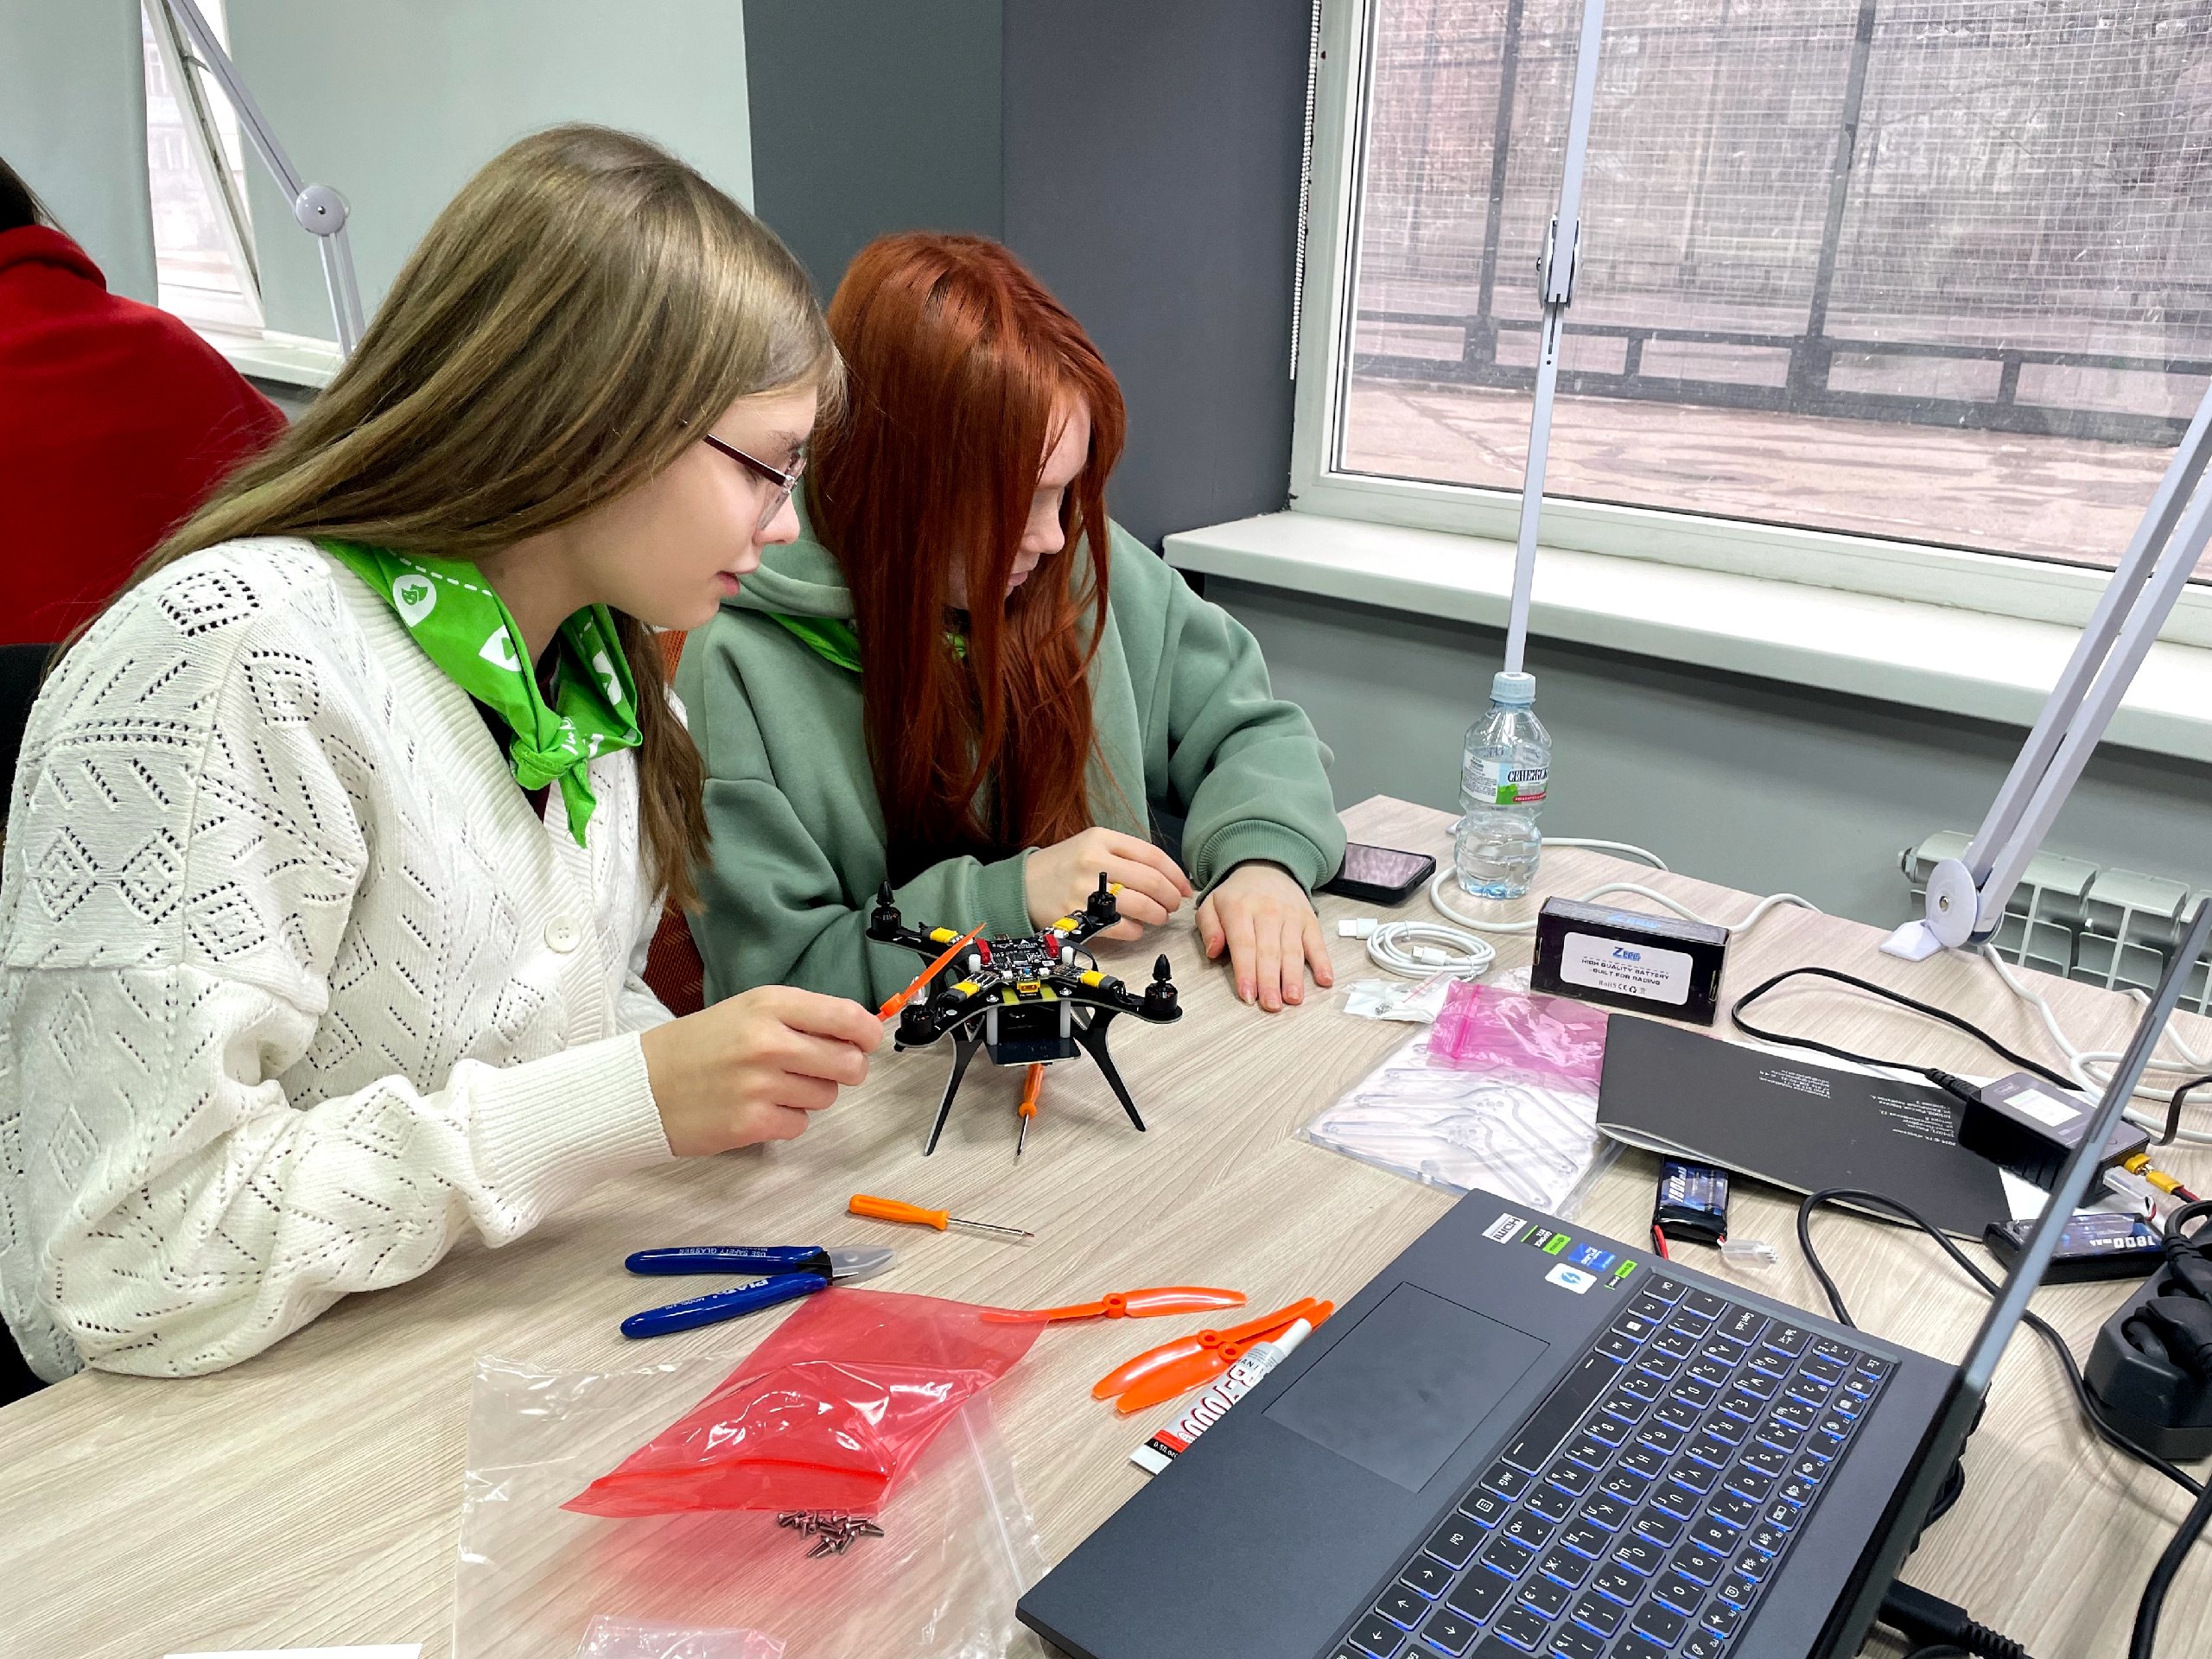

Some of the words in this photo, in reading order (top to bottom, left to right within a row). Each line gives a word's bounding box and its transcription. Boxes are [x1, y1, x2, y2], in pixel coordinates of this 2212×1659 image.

[1601, 963, 1632, 972] QUALITY
[1635, 969, 1669, 979] BATTERY
[1493, 1217, 1521, 1241] HDMI
[721, 1249, 748, 1257] SAFETY
